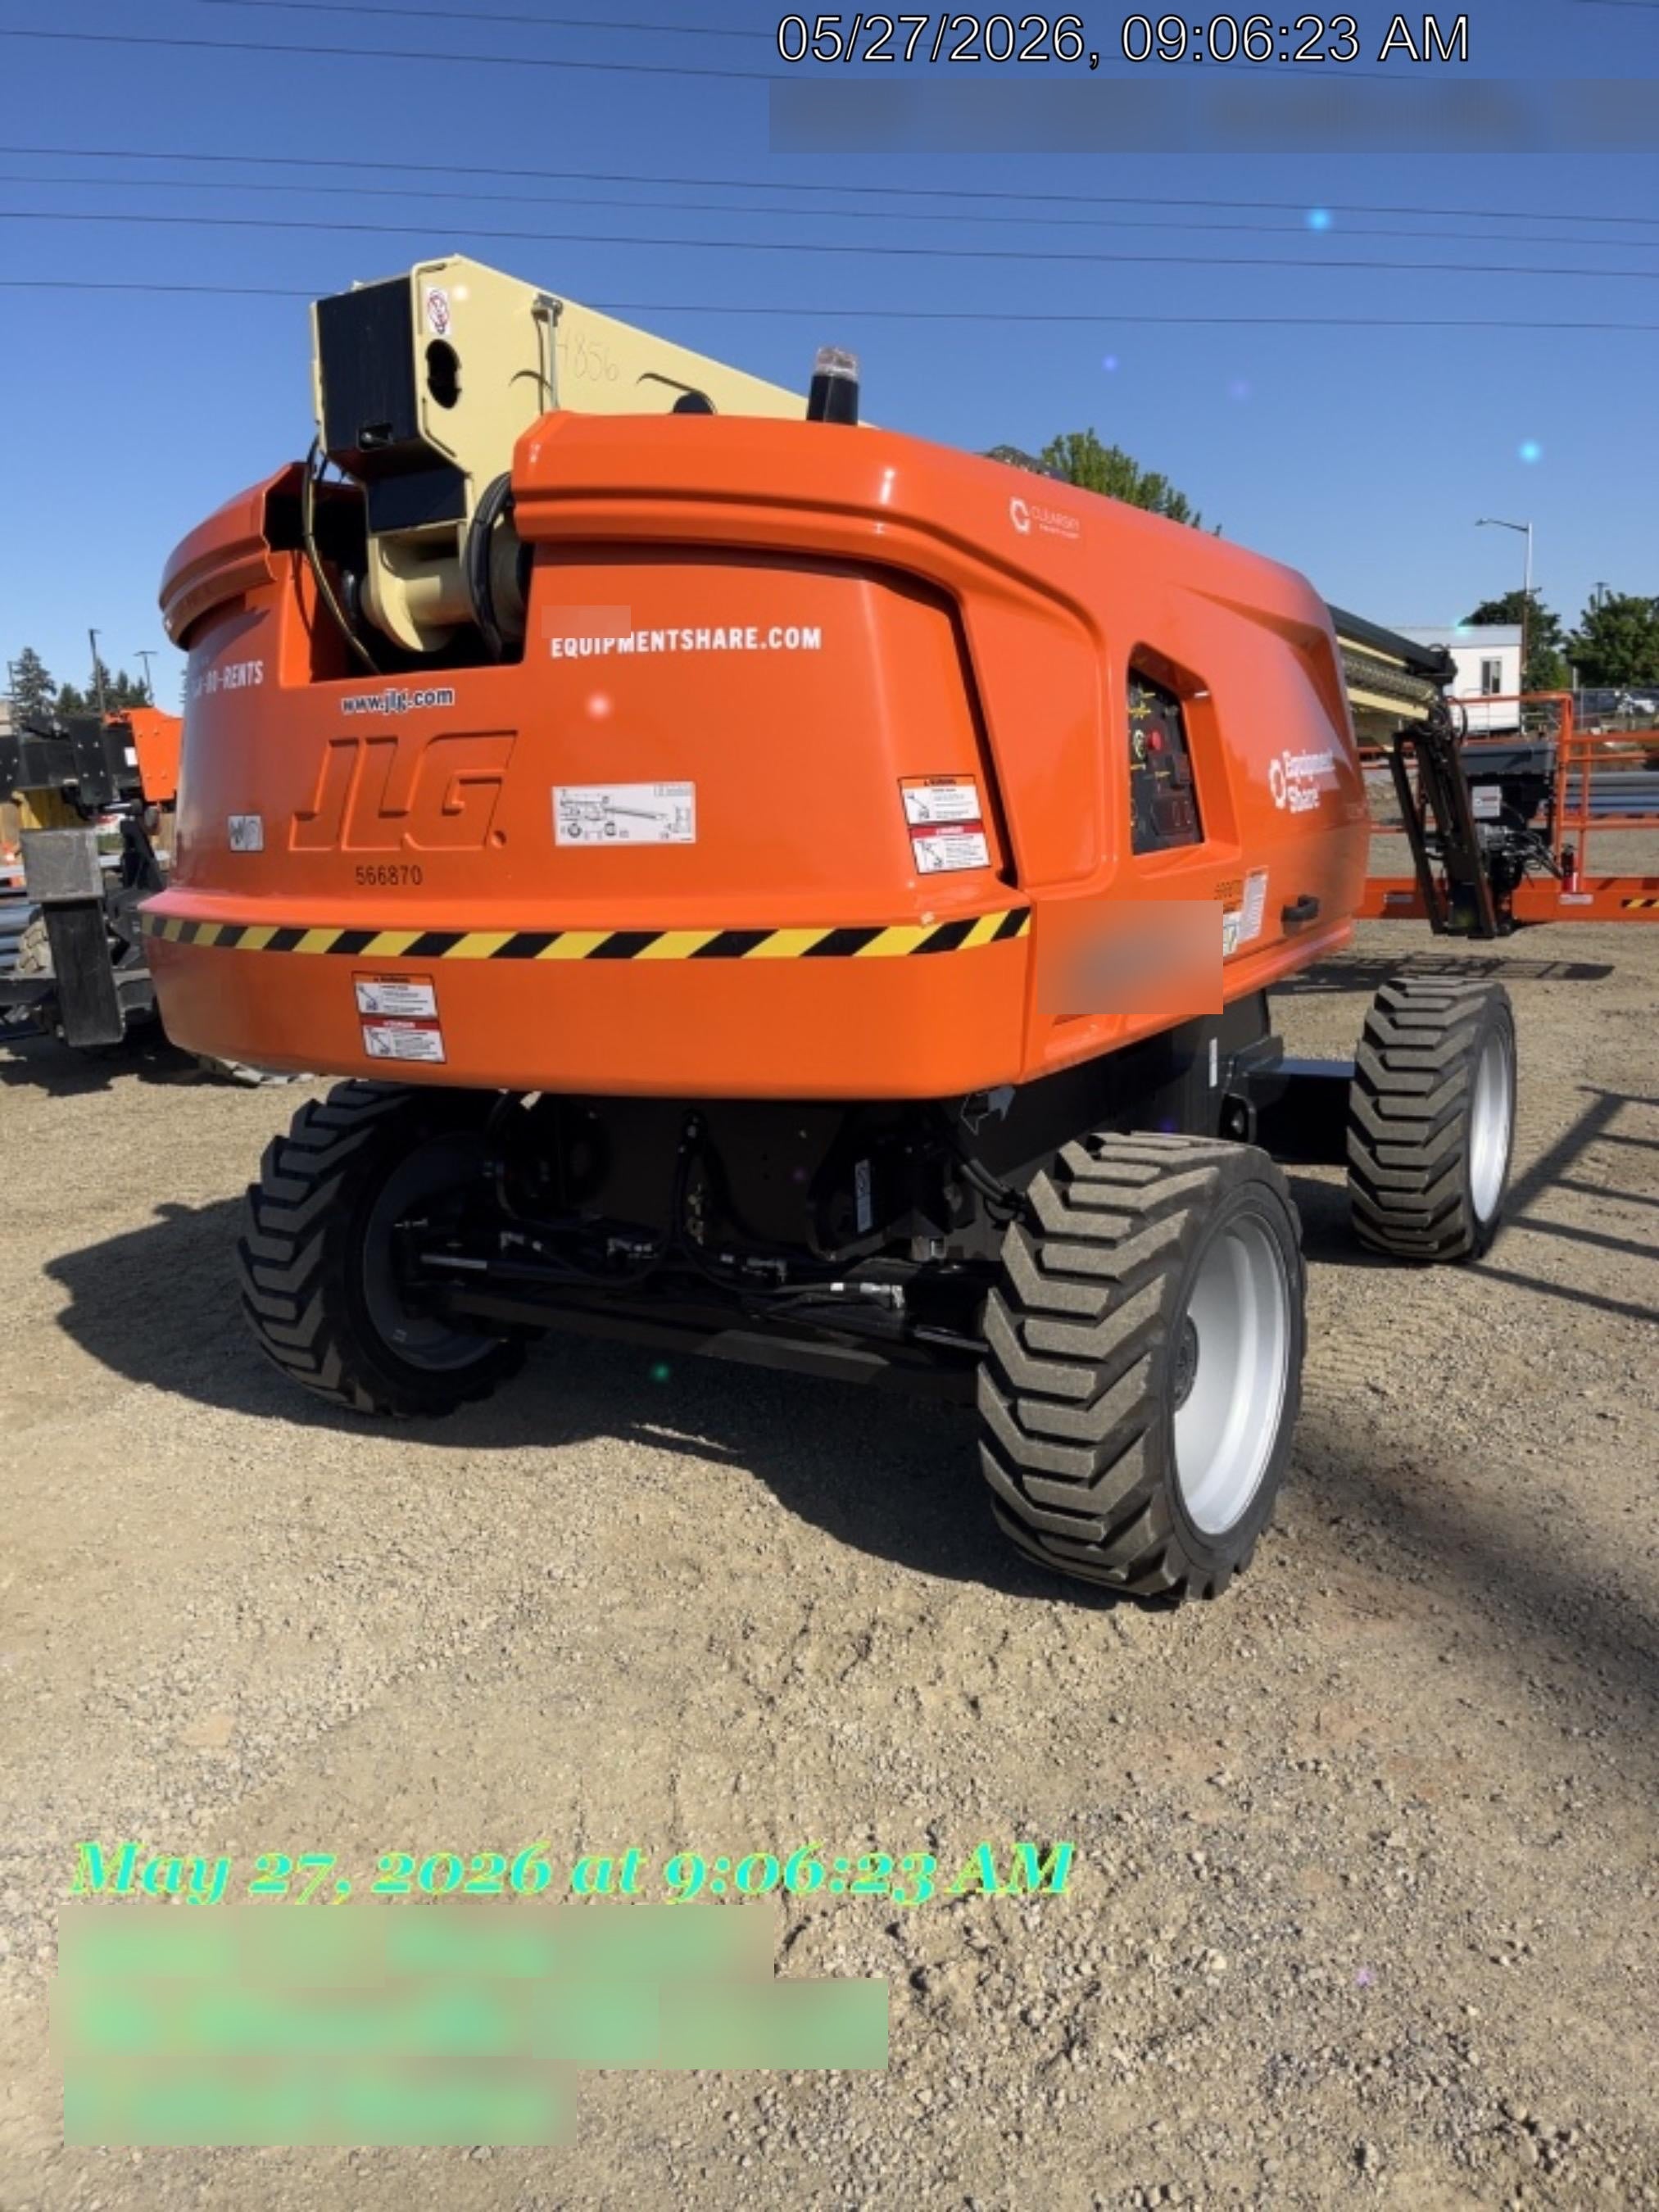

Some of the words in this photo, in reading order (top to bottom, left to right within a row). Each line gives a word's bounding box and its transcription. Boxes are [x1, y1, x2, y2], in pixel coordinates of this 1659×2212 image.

[551, 626, 822, 659] EQUIPMENTSHARE.COM
[342, 687, 456, 715] www.jlg.com
[288, 728, 518, 851] JLG
[1288, 785, 1321, 814] Share
[355, 864, 423, 886] 566870
